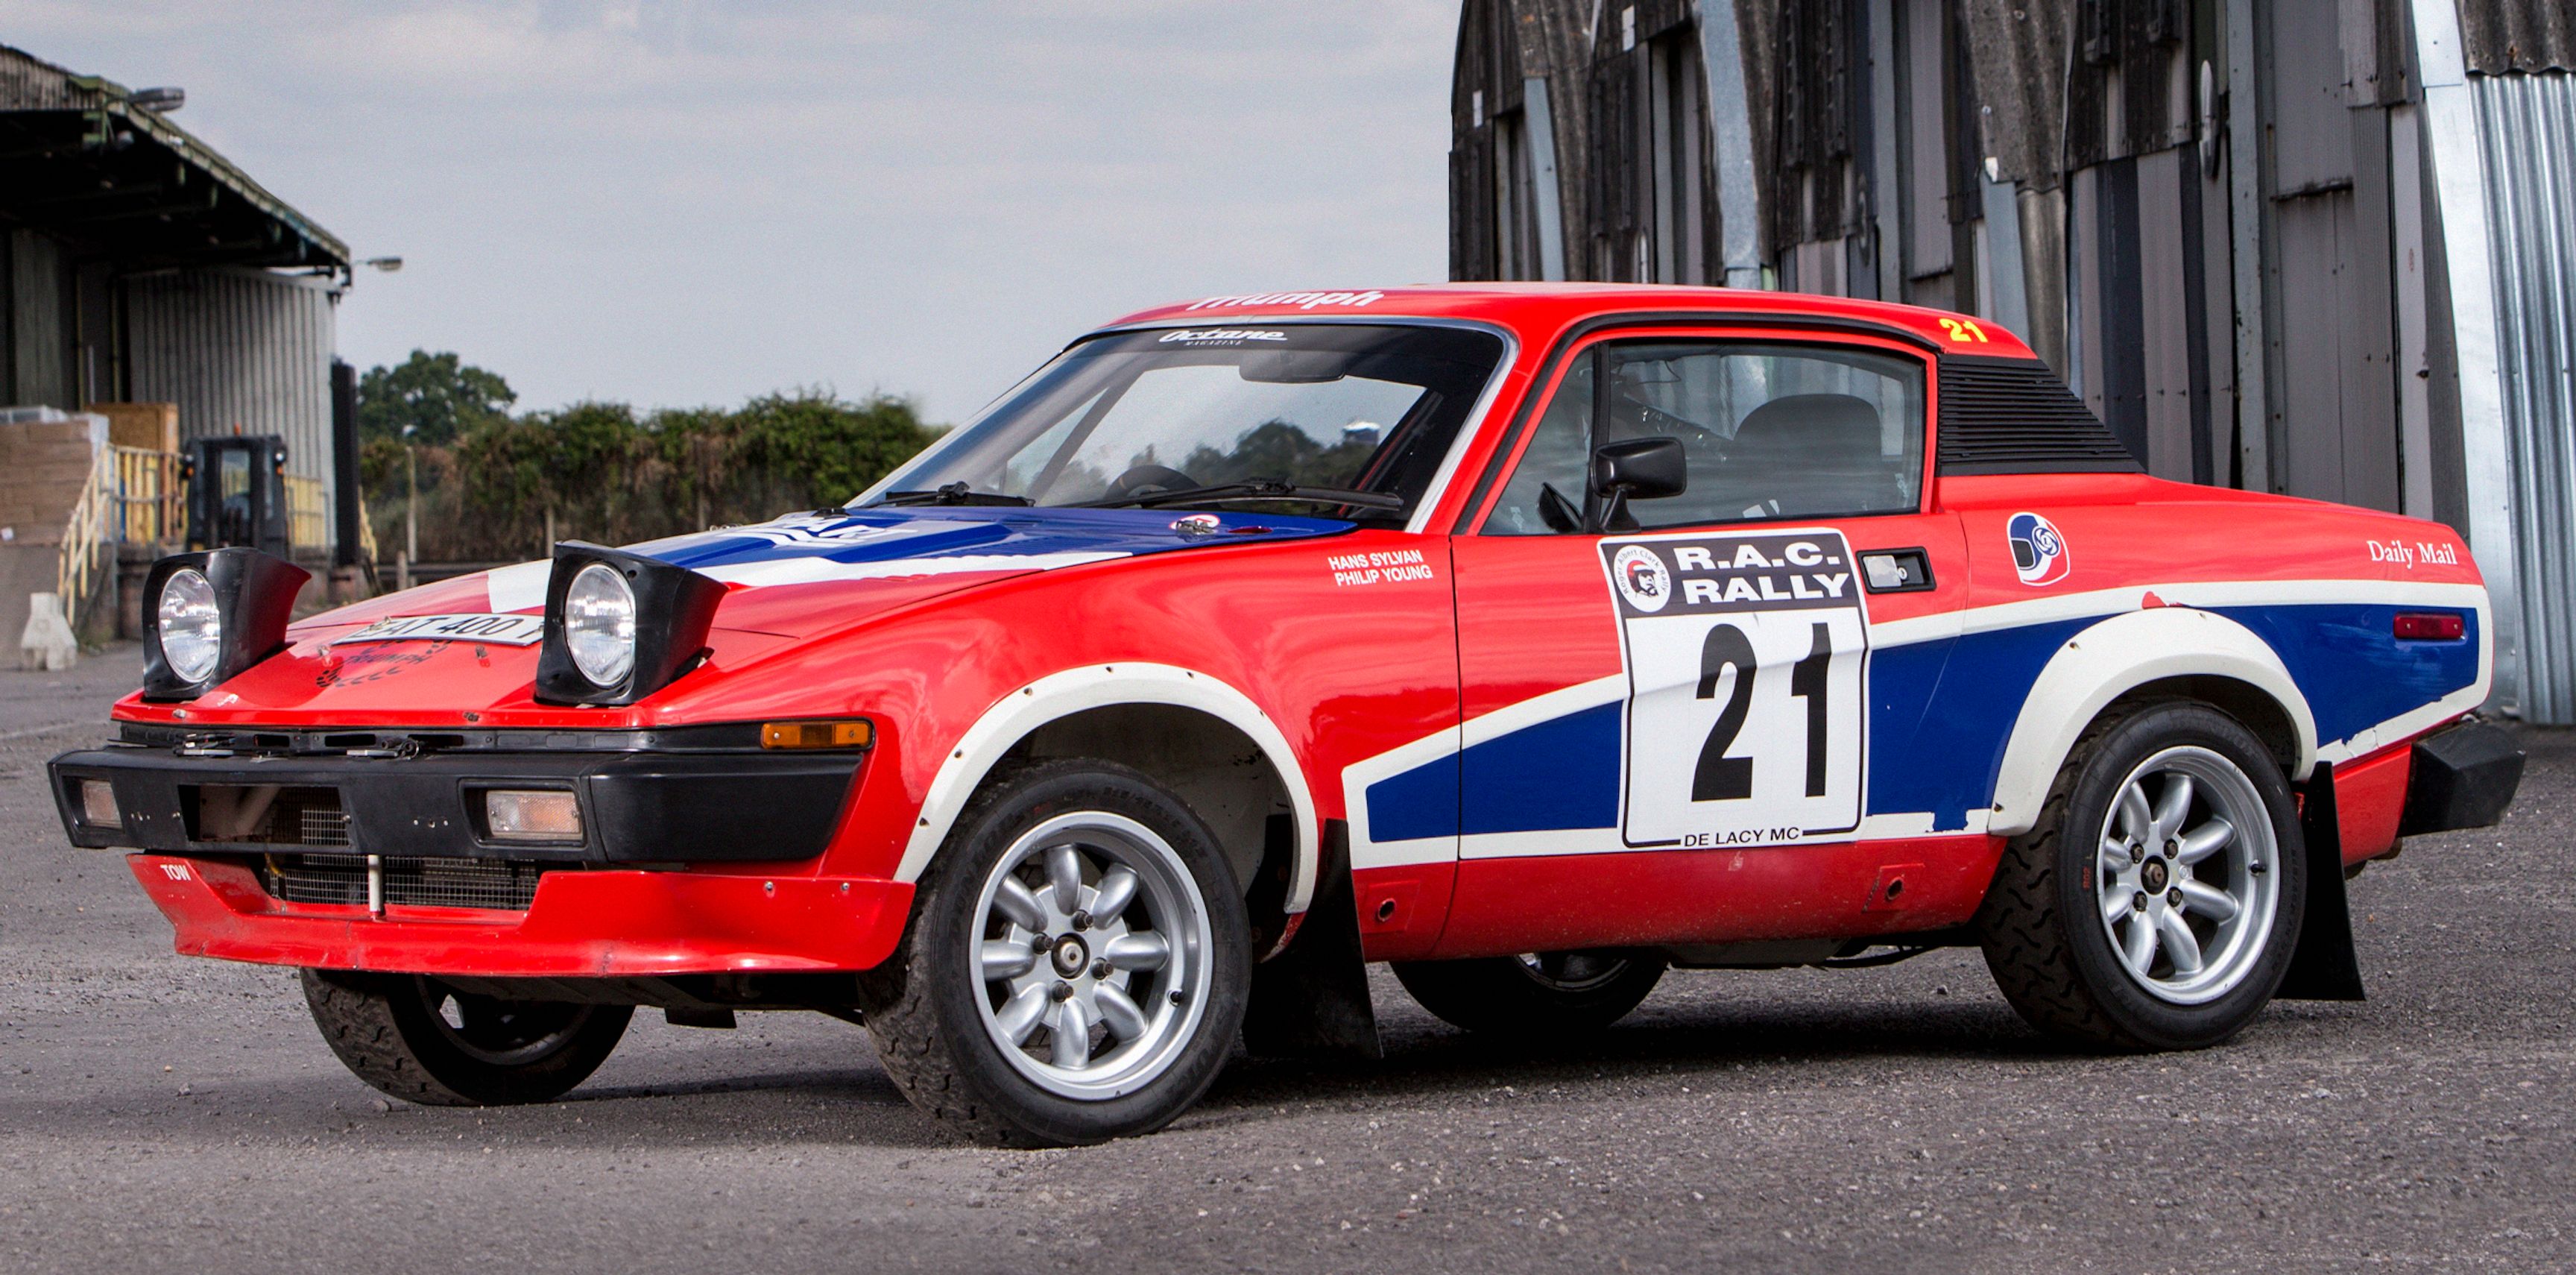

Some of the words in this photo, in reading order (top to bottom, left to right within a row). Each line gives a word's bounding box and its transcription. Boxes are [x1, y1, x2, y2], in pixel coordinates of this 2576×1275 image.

[1158, 328, 1288, 343] Octane
[1939, 318, 1989, 343] 21
[1328, 553, 1369, 570] HANS
[1369, 549, 1424, 567] SYLVAN
[1617, 550, 1638, 564] Albert
[1640, 550, 1659, 568] Clark
[1673, 541, 1841, 571] R.A.C.
[2366, 540, 2414, 570] Daily
[2416, 542, 2458, 565] Mail
[1334, 569, 1380, 587] PHILIP
[1380, 564, 1433, 582] YOUNG
[1617, 567, 1629, 595] Roger
[1659, 569, 1669, 593] Rally
[1682, 572, 1850, 605] RALLY
[435, 616, 525, 636] 400
[1691, 622, 1833, 802] 21
[1685, 833, 1710, 847] DE
[1715, 828, 1764, 845] LACY
[1770, 827, 1799, 841] MC
[160, 864, 192, 881] TOW
